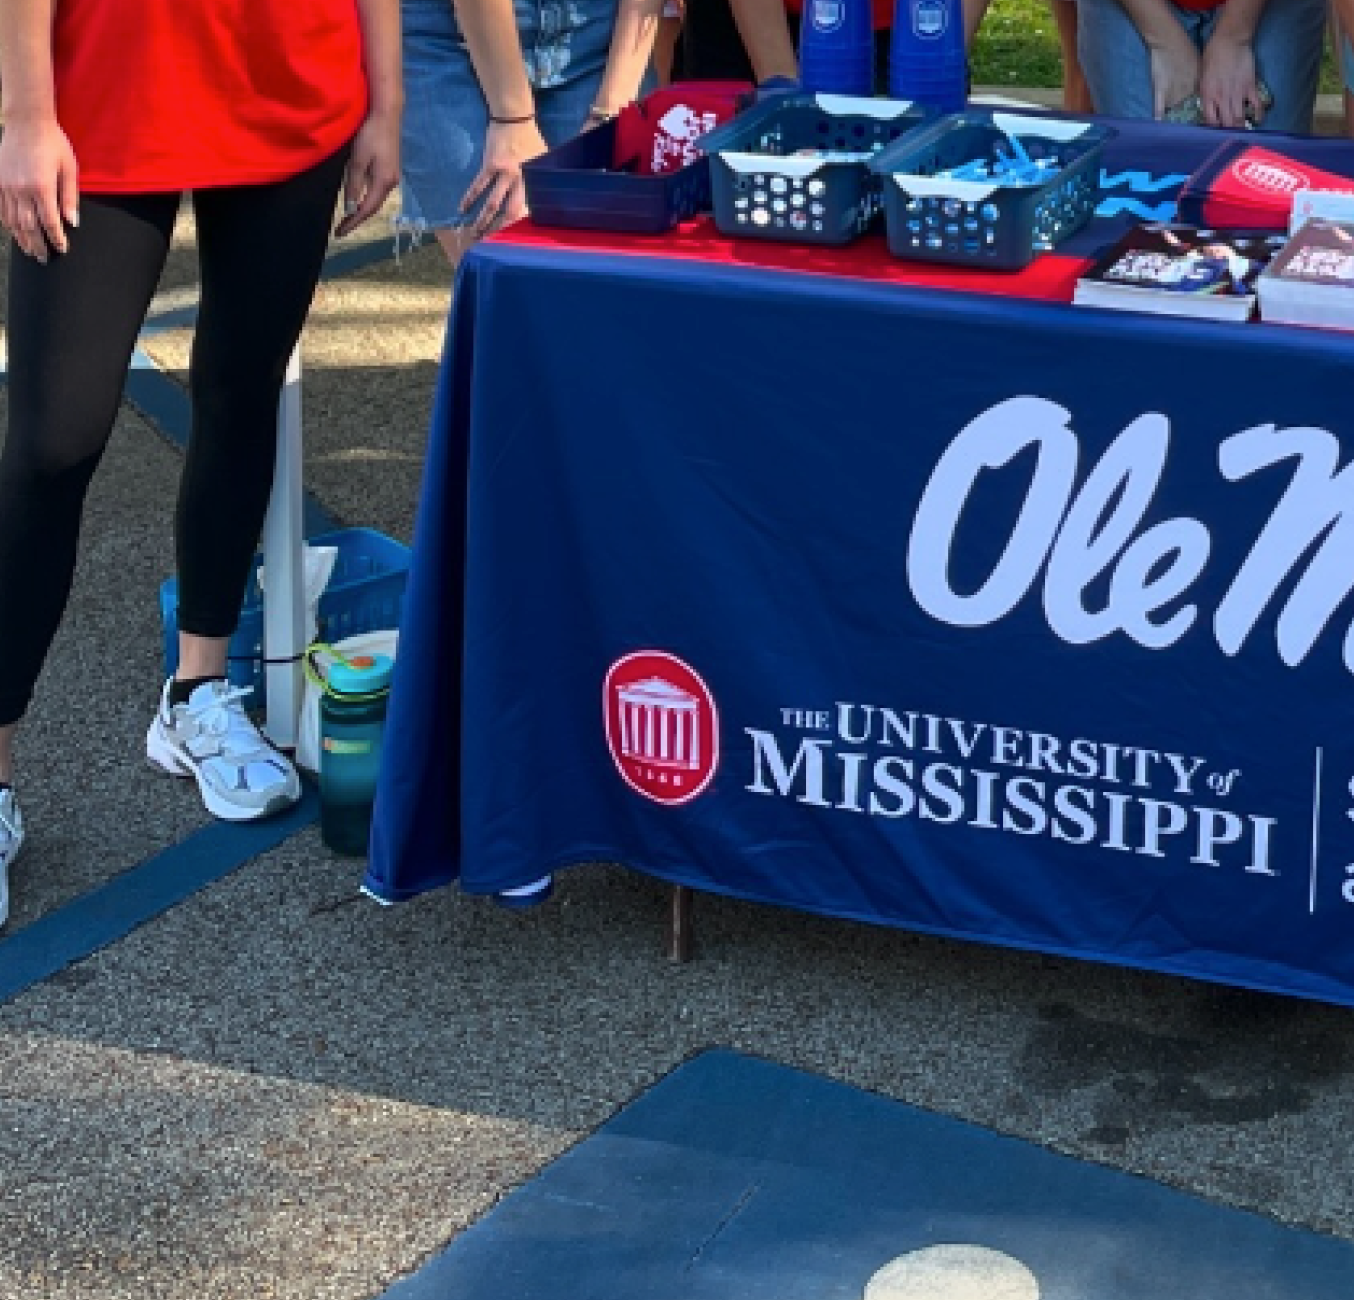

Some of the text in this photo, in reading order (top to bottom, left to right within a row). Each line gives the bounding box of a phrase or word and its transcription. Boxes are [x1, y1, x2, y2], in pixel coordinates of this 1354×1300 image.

[905, 394, 1211, 650] Ole
[744, 726, 1281, 877] MISSISSIPPI
[779, 701, 1242, 797] THE UNIVERSITY of
